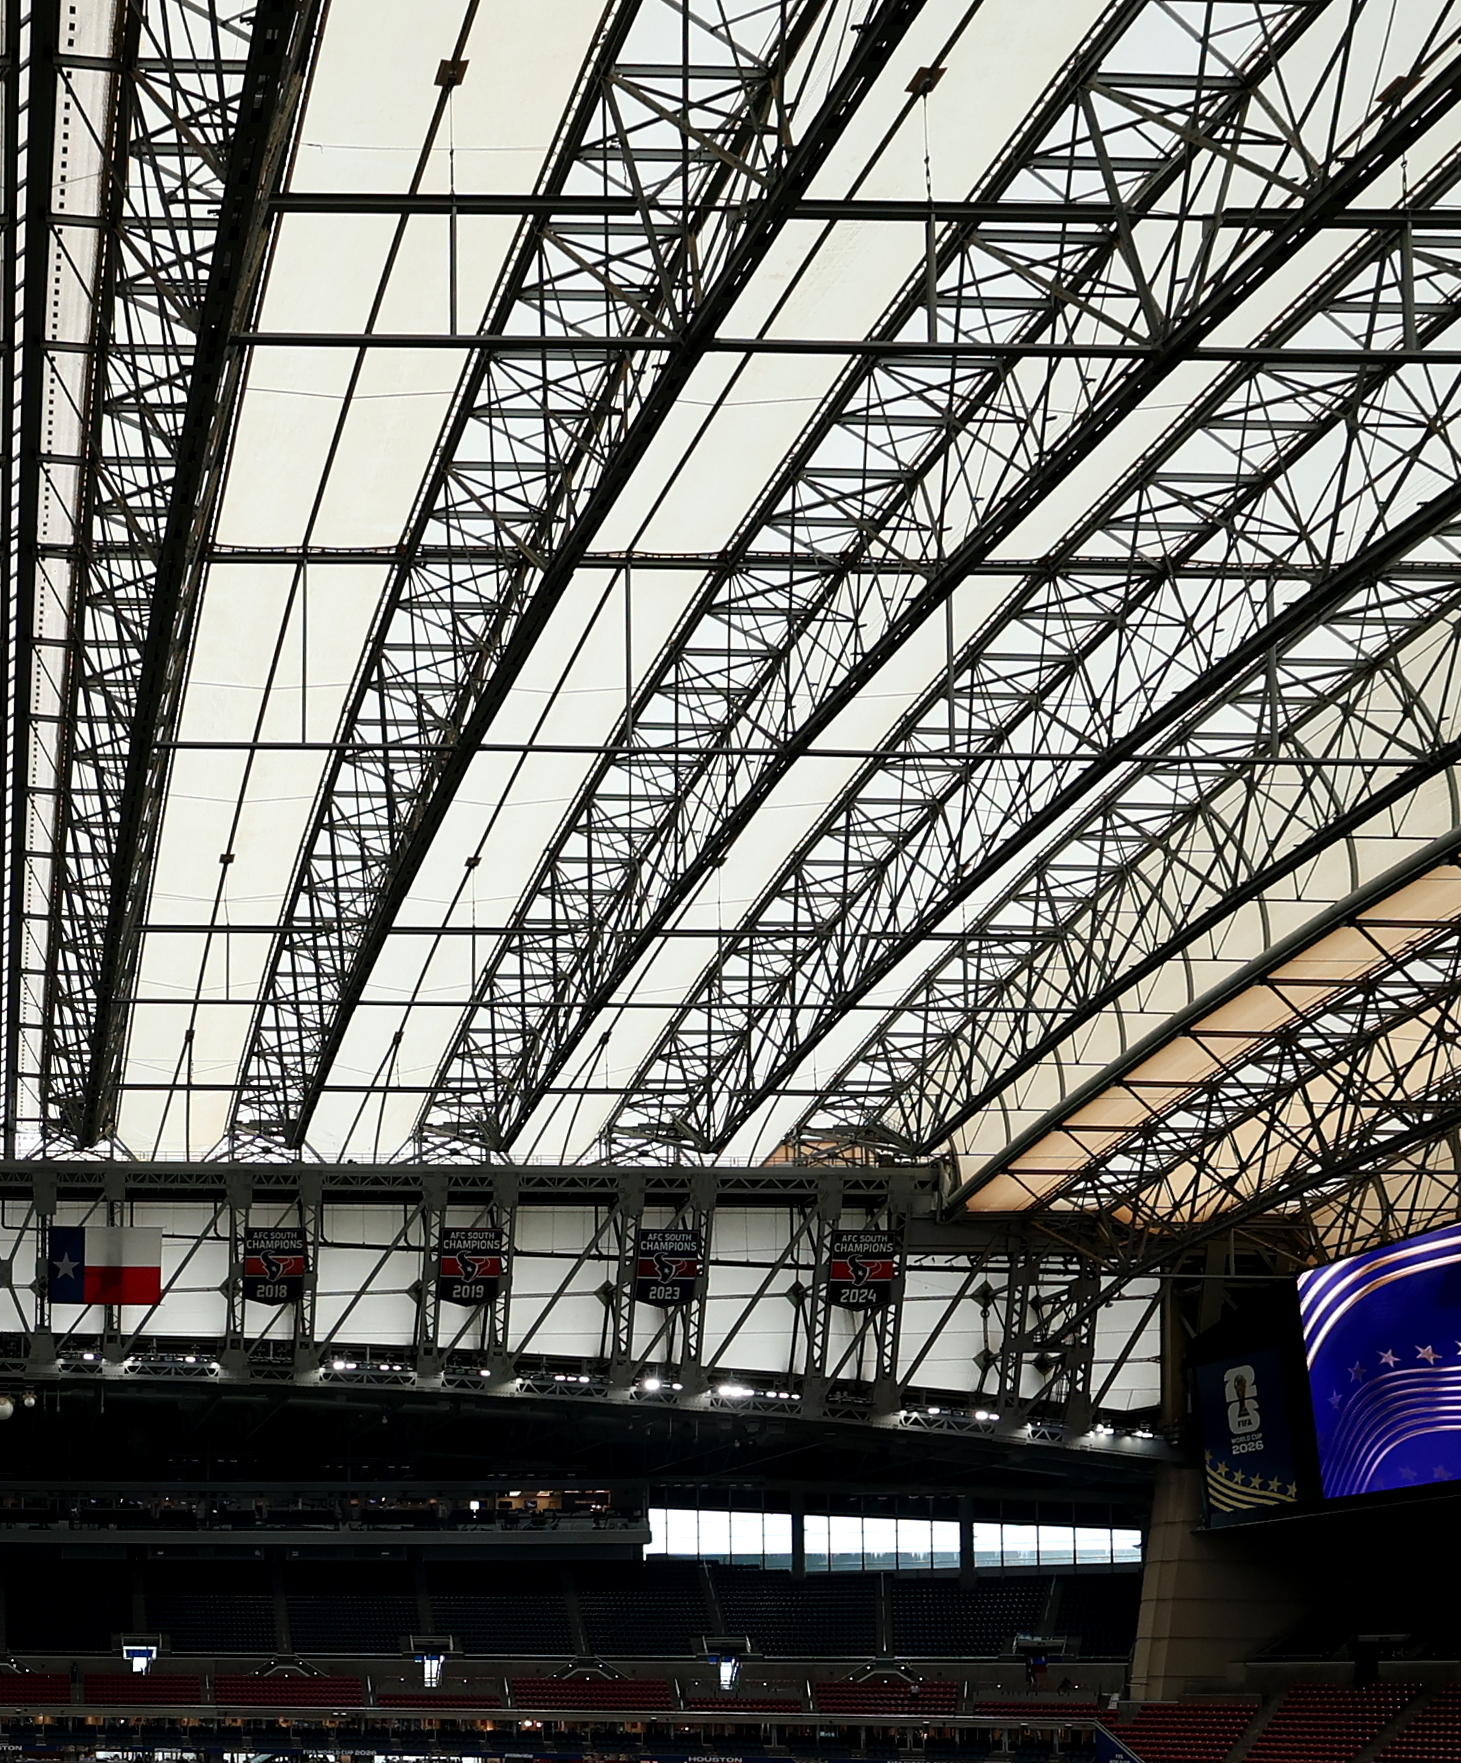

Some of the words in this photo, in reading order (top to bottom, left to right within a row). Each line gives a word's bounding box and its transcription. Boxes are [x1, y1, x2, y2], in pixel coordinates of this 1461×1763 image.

[647, 1233, 663, 1241] AFC
[665, 1233, 691, 1241] SOUTH
[246, 1240, 303, 1249] CHAMPIONS
[443, 1240, 500, 1249] CHAMPIONS
[640, 1241, 697, 1251] CHAMPIONS
[834, 1243, 893, 1253] CHAMPIONS
[256, 1285, 287, 1297] 2018
[452, 1285, 484, 1298] 2019
[649, 1287, 680, 1299] 2023
[840, 1289, 876, 1303] 2024
[1238, 1418, 1253, 1428] FIFA
[1232, 1441, 1264, 1455] 2026
